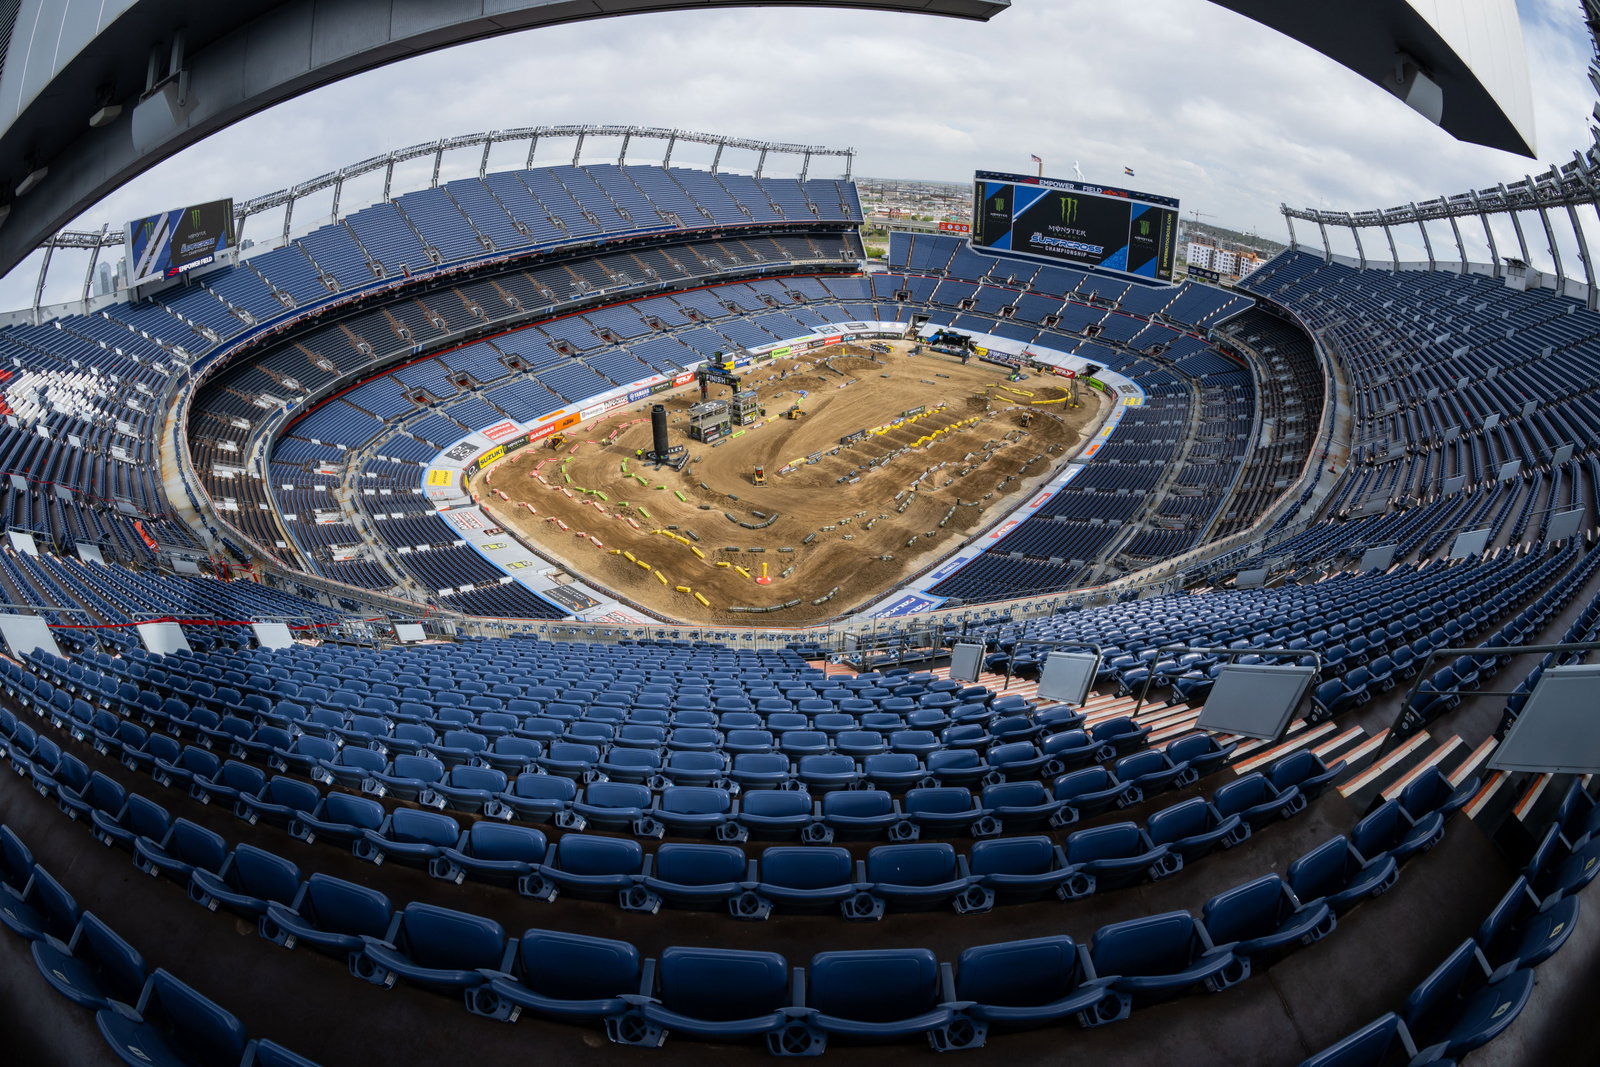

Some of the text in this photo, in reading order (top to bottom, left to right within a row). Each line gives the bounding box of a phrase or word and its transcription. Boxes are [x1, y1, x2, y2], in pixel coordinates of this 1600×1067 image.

[1039, 179, 1075, 190] EMPOWER
[1082, 185, 1103, 194] FIELD
[1048, 225, 1087, 237] MONSTER
[1029, 235, 1105, 254] SUPERCROSS
[1162, 213, 1172, 268] SUPERMOTOCROSS.COM
[1044, 245, 1087, 257] CHAMPIONSHIP
[179, 256, 213, 272] EMPOWER FIELD
[706, 374, 726, 384] FINISH
[563, 418, 574, 426] KTM
[530, 426, 555, 439] GASGAS
[480, 448, 503, 465] SUZUKI
